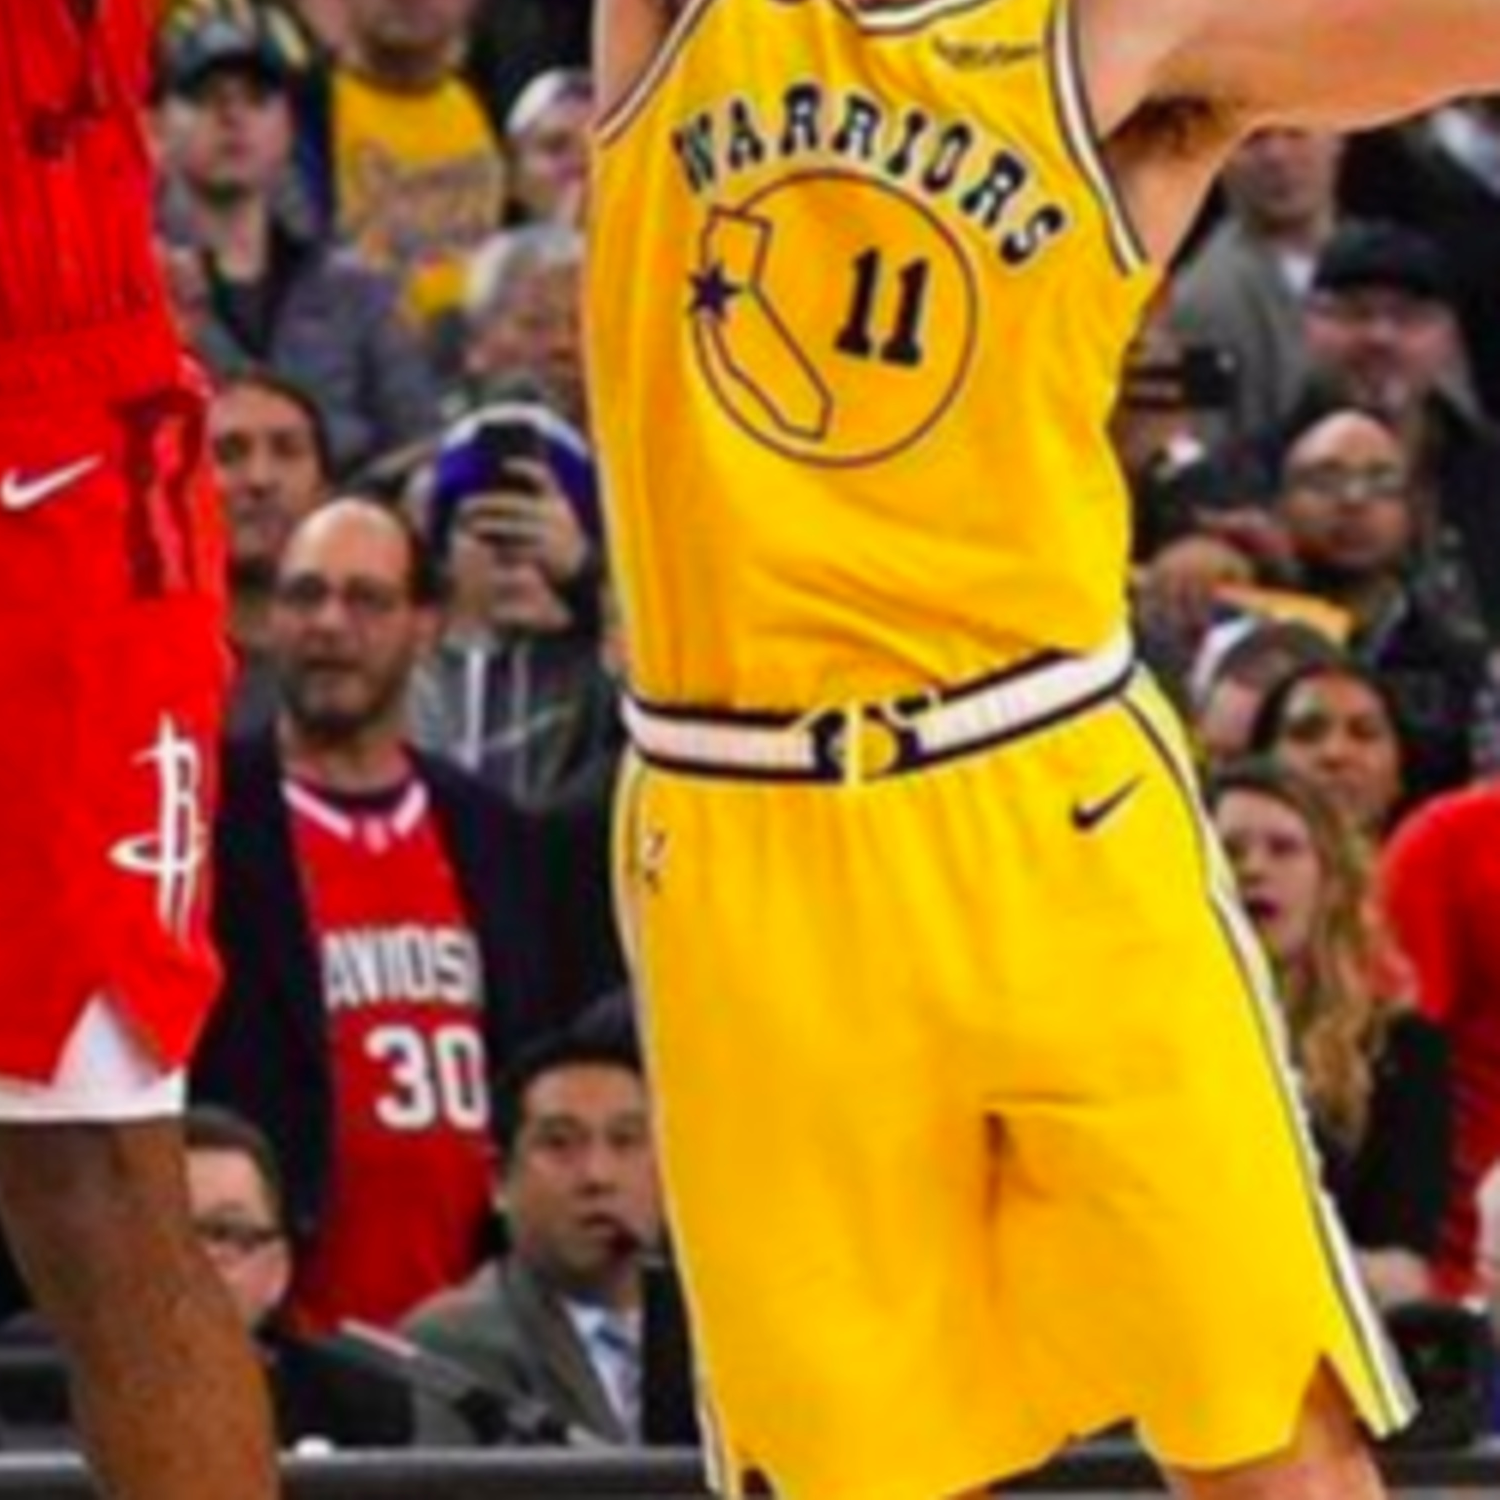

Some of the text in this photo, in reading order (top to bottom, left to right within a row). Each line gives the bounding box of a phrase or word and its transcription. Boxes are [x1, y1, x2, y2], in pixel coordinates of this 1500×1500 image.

[670, 82, 1068, 267] WARRIORS
[833, 244, 930, 369] 11
[365, 1024, 489, 1130] 30
